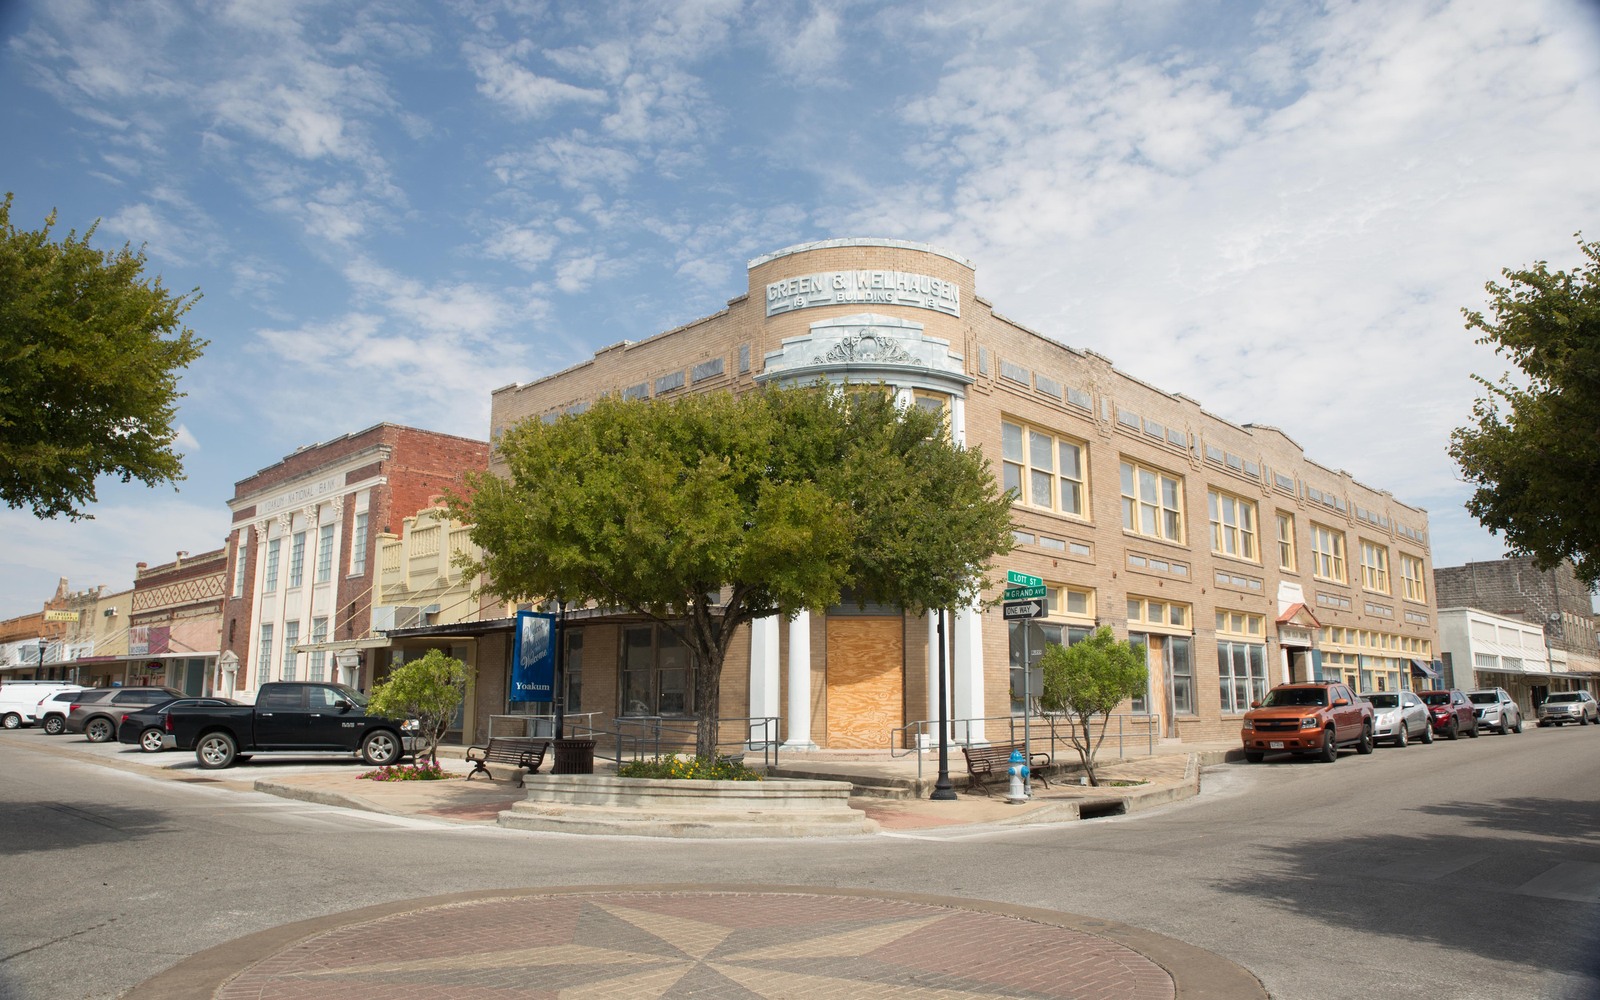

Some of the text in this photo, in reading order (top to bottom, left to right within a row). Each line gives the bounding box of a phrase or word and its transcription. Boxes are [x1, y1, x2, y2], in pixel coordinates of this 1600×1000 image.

[768, 273, 958, 304] GREEN & WELHAUSEN
[836, 291, 893, 303] BUILDING
[318, 480, 336, 494] BANK
[1013, 574, 1037, 586] LOTT ST
[1011, 588, 1033, 598] GRAND
[1006, 605, 1031, 615] ONE WAY
[520, 649, 547, 670] Welcome
[516, 682, 550, 691] Yoakum
